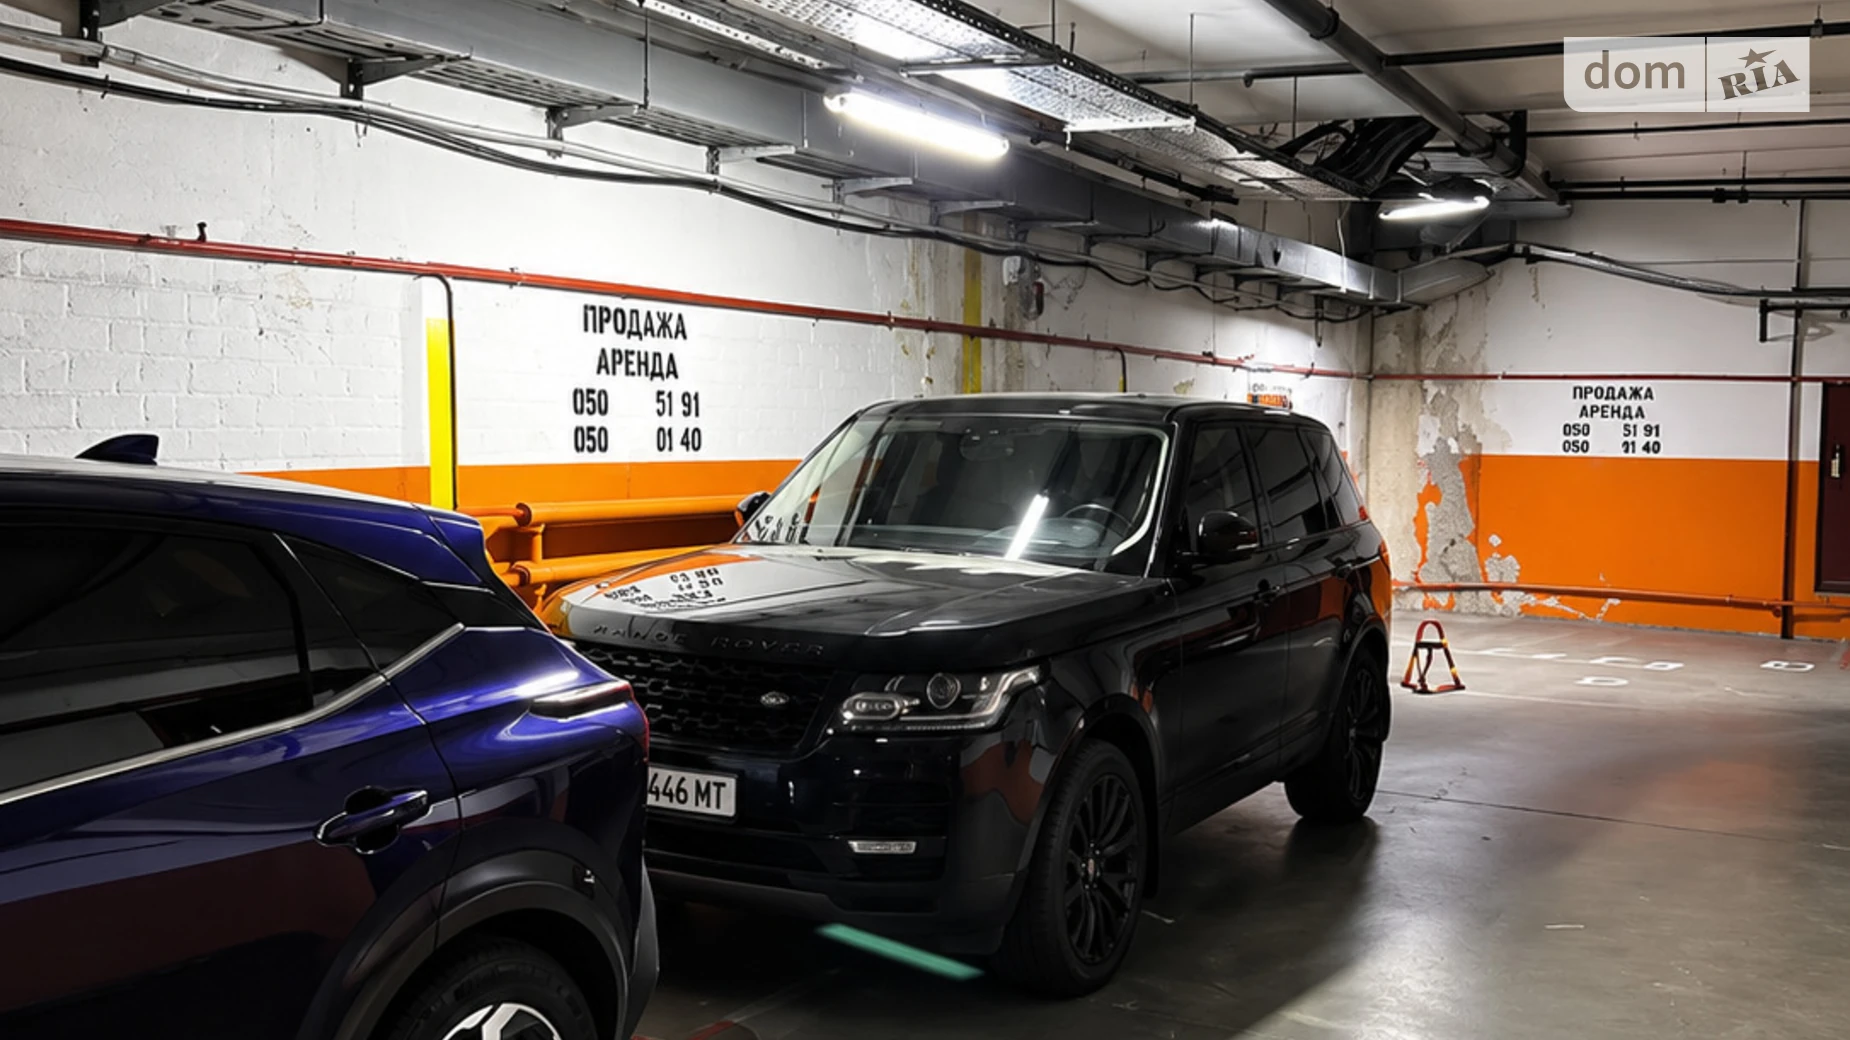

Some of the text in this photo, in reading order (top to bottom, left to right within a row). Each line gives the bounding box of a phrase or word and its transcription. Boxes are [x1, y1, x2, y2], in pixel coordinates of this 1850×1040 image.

[583, 304, 688, 341] ПРОДАЖА
[596, 347, 679, 381] АРЕНДА
[572, 387, 700, 418] 050 51 91
[1572, 385, 1654, 400] ПРОДАЖА
[1579, 404, 1645, 419] АРЕНДА
[574, 426, 702, 453] 050 01 40
[1643, 424, 1660, 437] 91
[1642, 440, 1661, 454] 40
[648, 772, 727, 810] 446 MT
